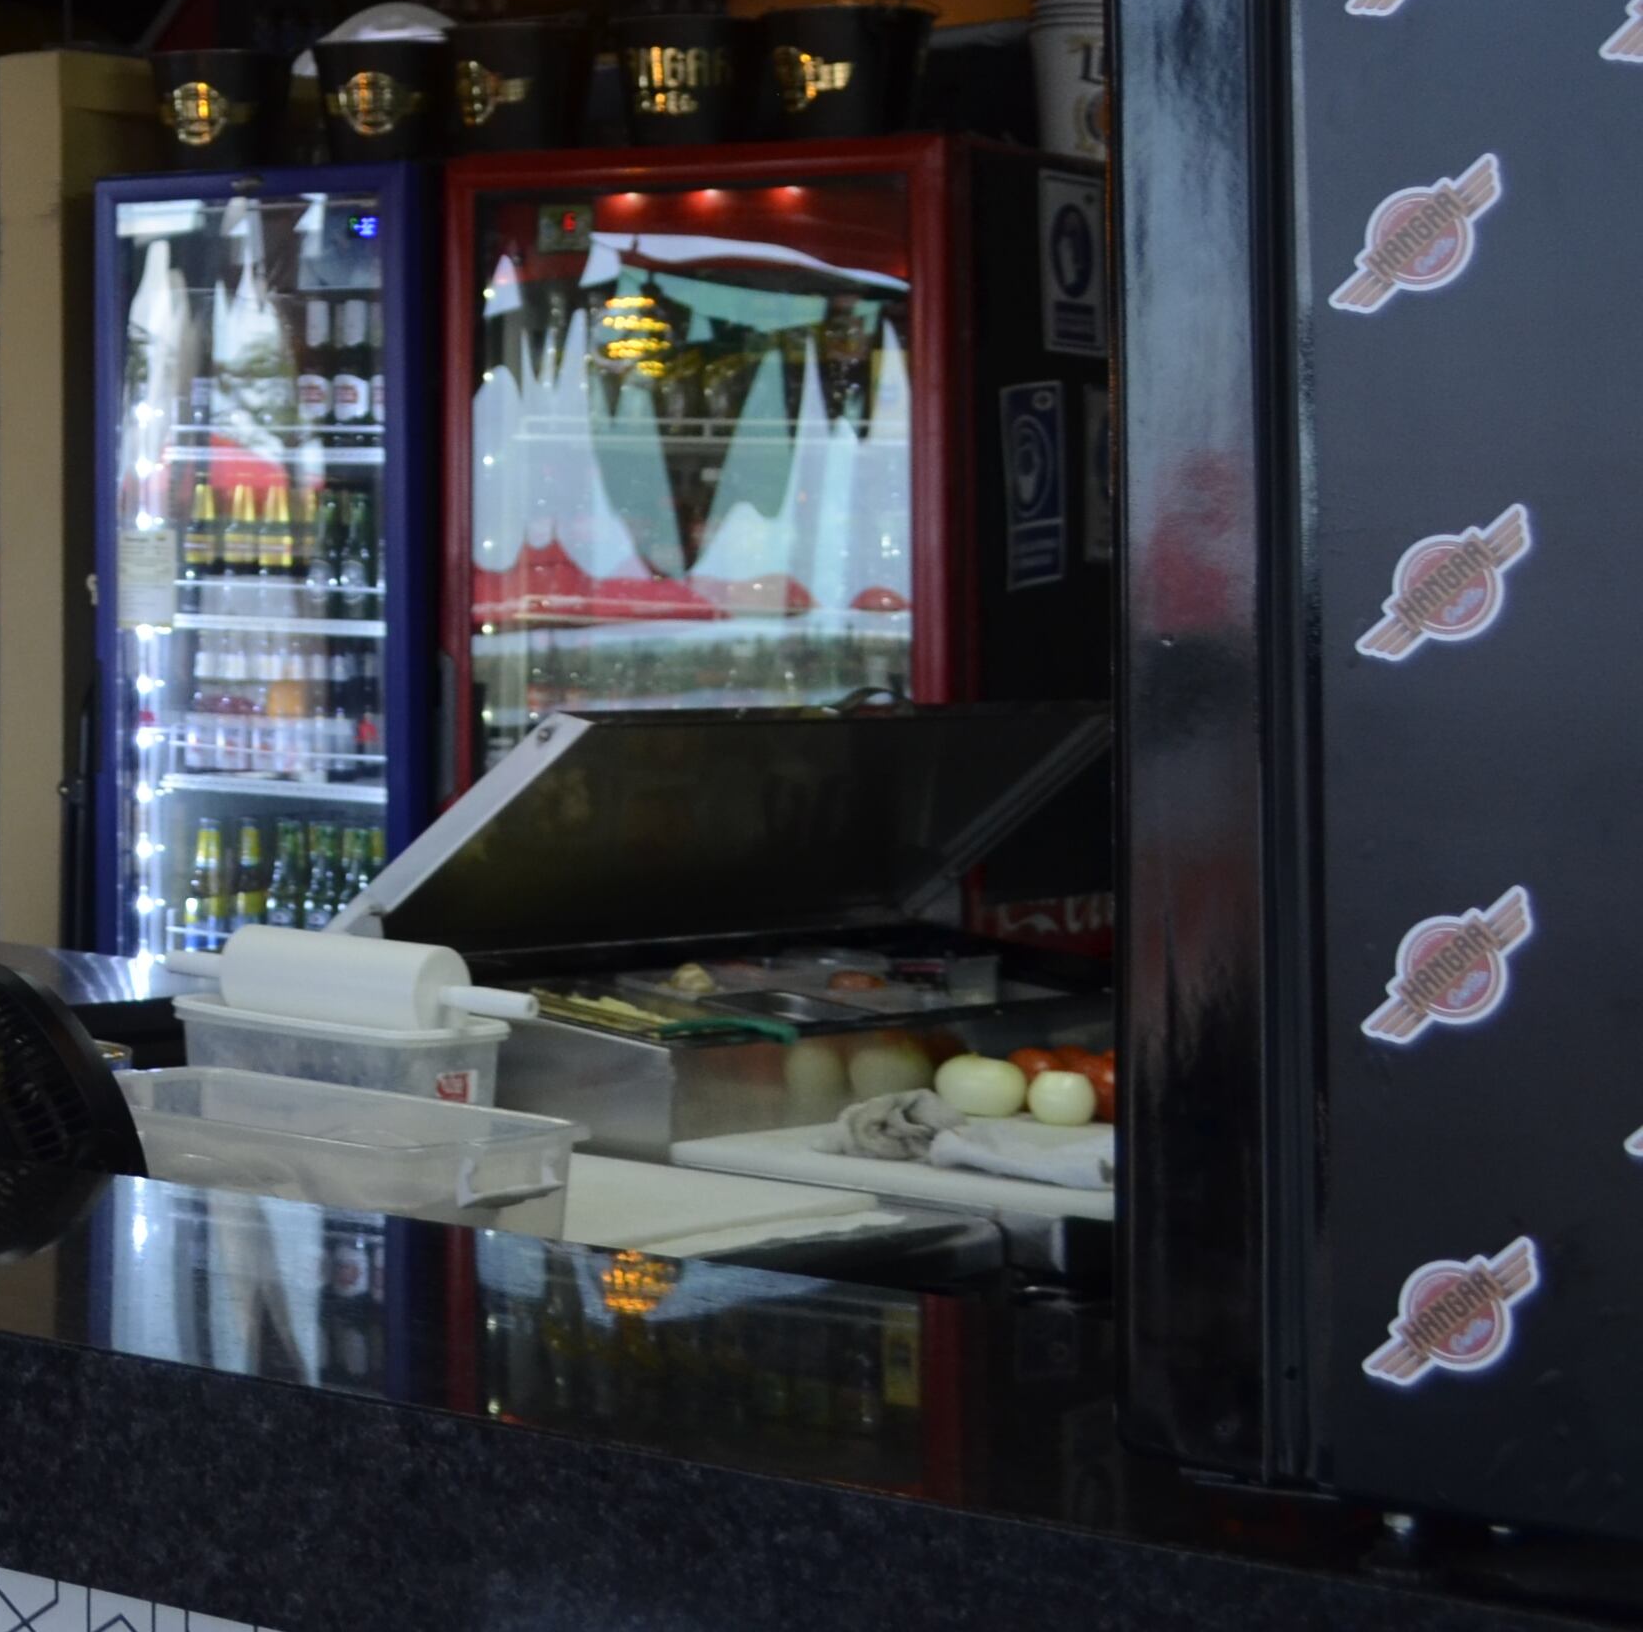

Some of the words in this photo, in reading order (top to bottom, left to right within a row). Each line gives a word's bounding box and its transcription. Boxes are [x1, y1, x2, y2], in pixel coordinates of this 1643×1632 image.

[1369, 188, 1462, 276] HANGAR
[1397, 539, 1486, 625] HANGAR
[1403, 918, 1492, 1010] HANGAR
[1402, 1270, 1495, 1351] HANGAR
